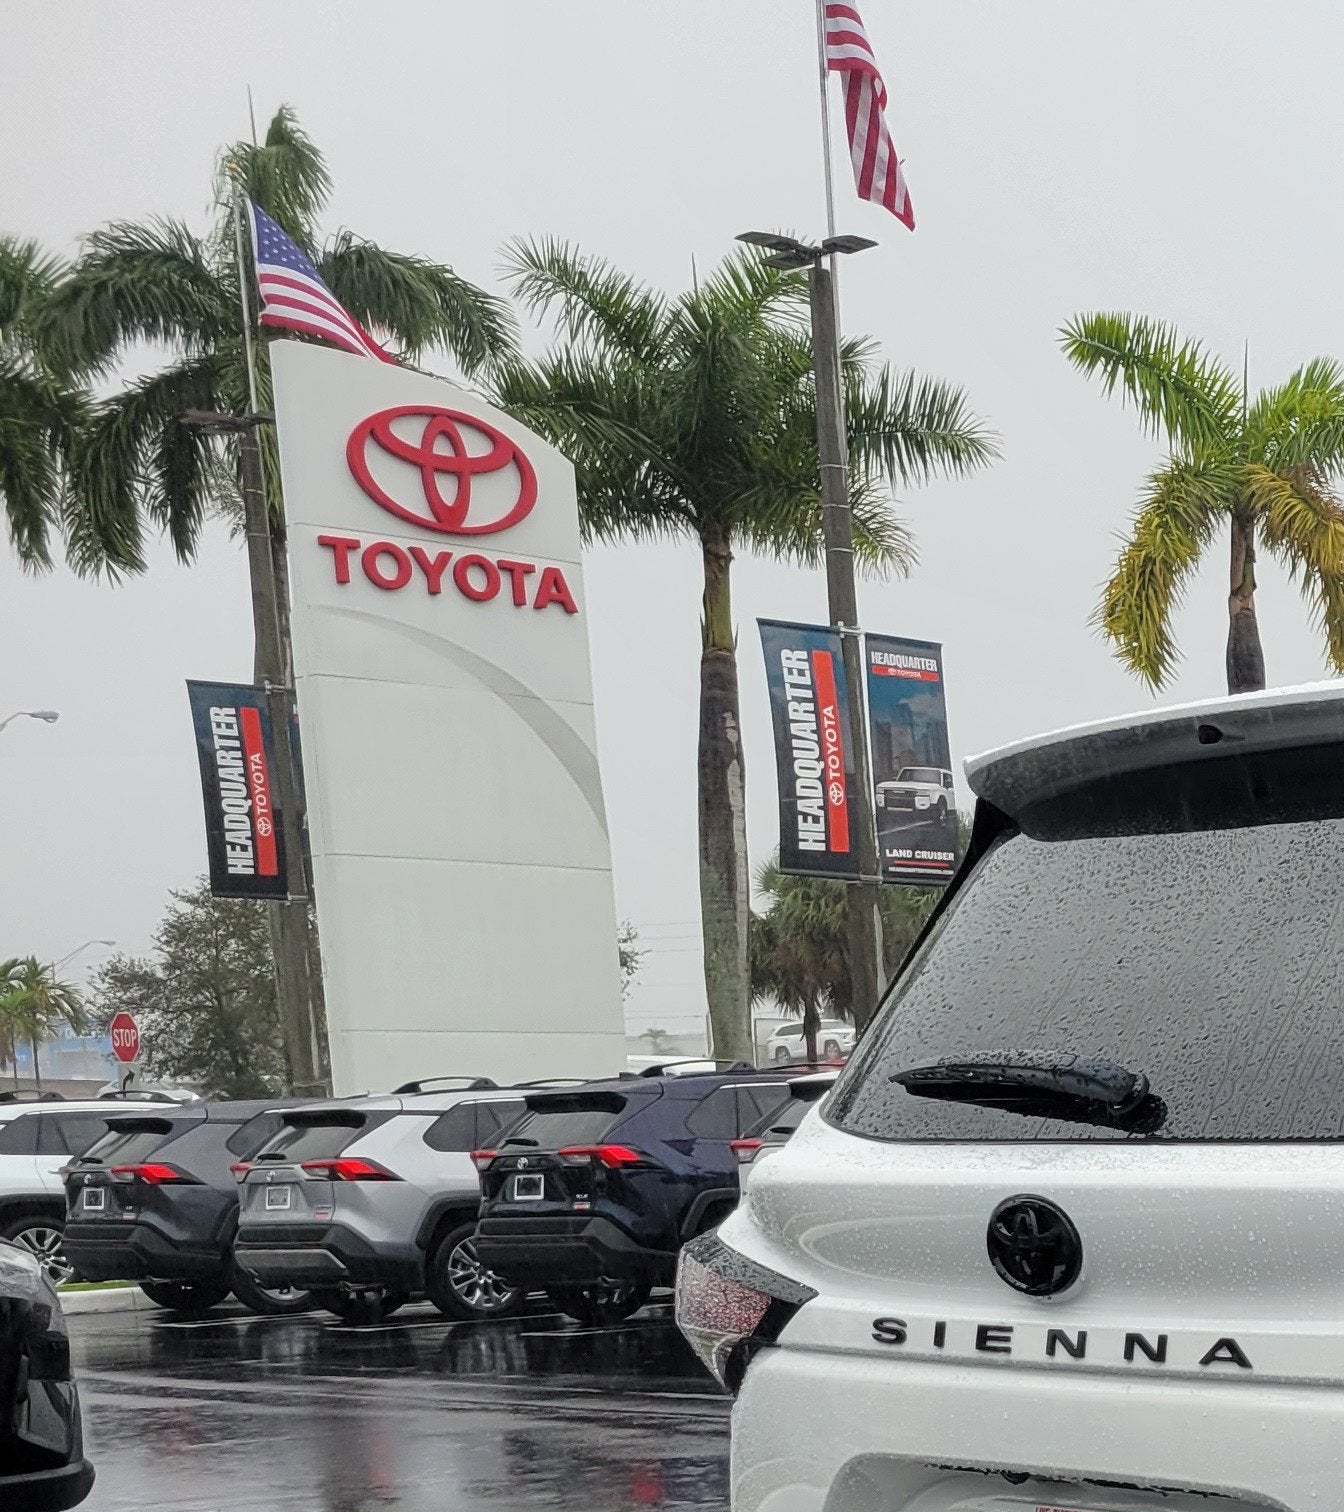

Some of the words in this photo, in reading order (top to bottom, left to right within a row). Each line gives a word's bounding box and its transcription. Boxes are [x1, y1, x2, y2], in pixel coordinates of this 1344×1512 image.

[317, 535, 578, 614] TOYOTA
[871, 651, 938, 672] HEADQUARTER
[780, 649, 827, 851] HEADQUARTER
[823, 705, 841, 780] TOYOTA
[209, 706, 255, 875] HEADQUARTER
[250, 752, 268, 813] TOYOTA
[885, 848, 912, 858] LAND
[914, 850, 955, 861] CRUISER
[113, 1029, 137, 1048] STOP
[871, 1316, 1253, 1369] SIENNA
